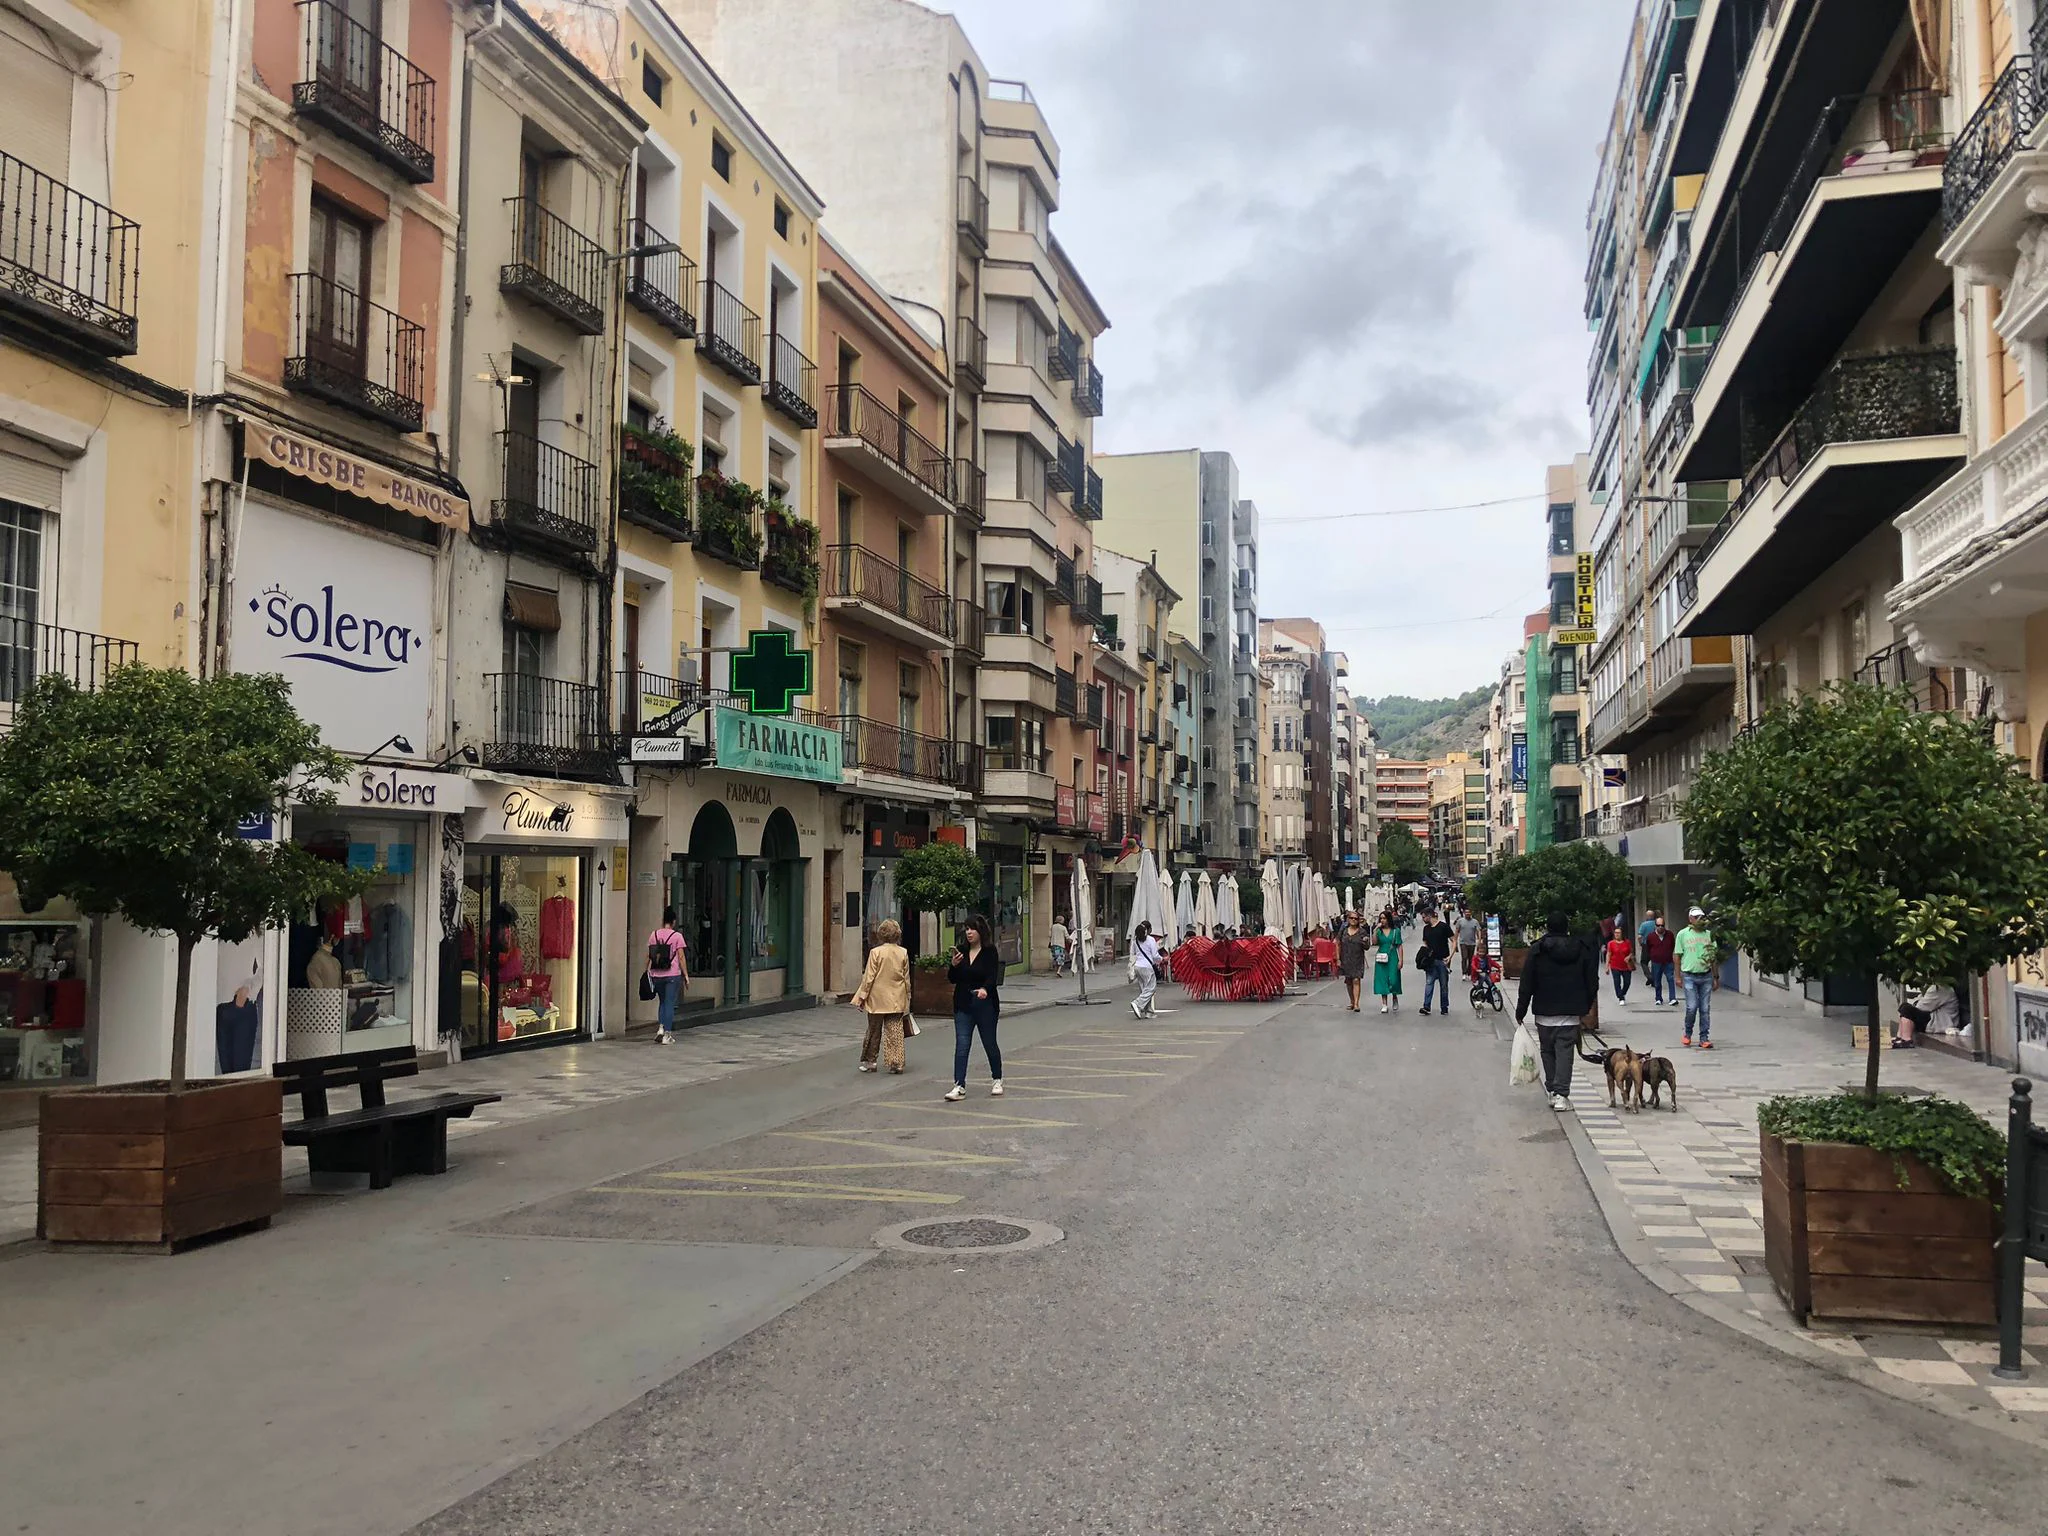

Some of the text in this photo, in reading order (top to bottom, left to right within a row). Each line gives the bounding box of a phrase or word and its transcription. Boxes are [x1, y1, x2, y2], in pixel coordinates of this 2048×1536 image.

[270, 434, 366, 490] CRISBE
[1578, 555, 1591, 614] HOSTAL
[266, 585, 412, 664] solera
[1559, 632, 1595, 642] AVENIDA
[634, 739, 681, 754] Plumetti
[738, 720, 829, 762] FARMACIA
[360, 770, 436, 805] Solera
[726, 781, 772, 806] FARMACIA
